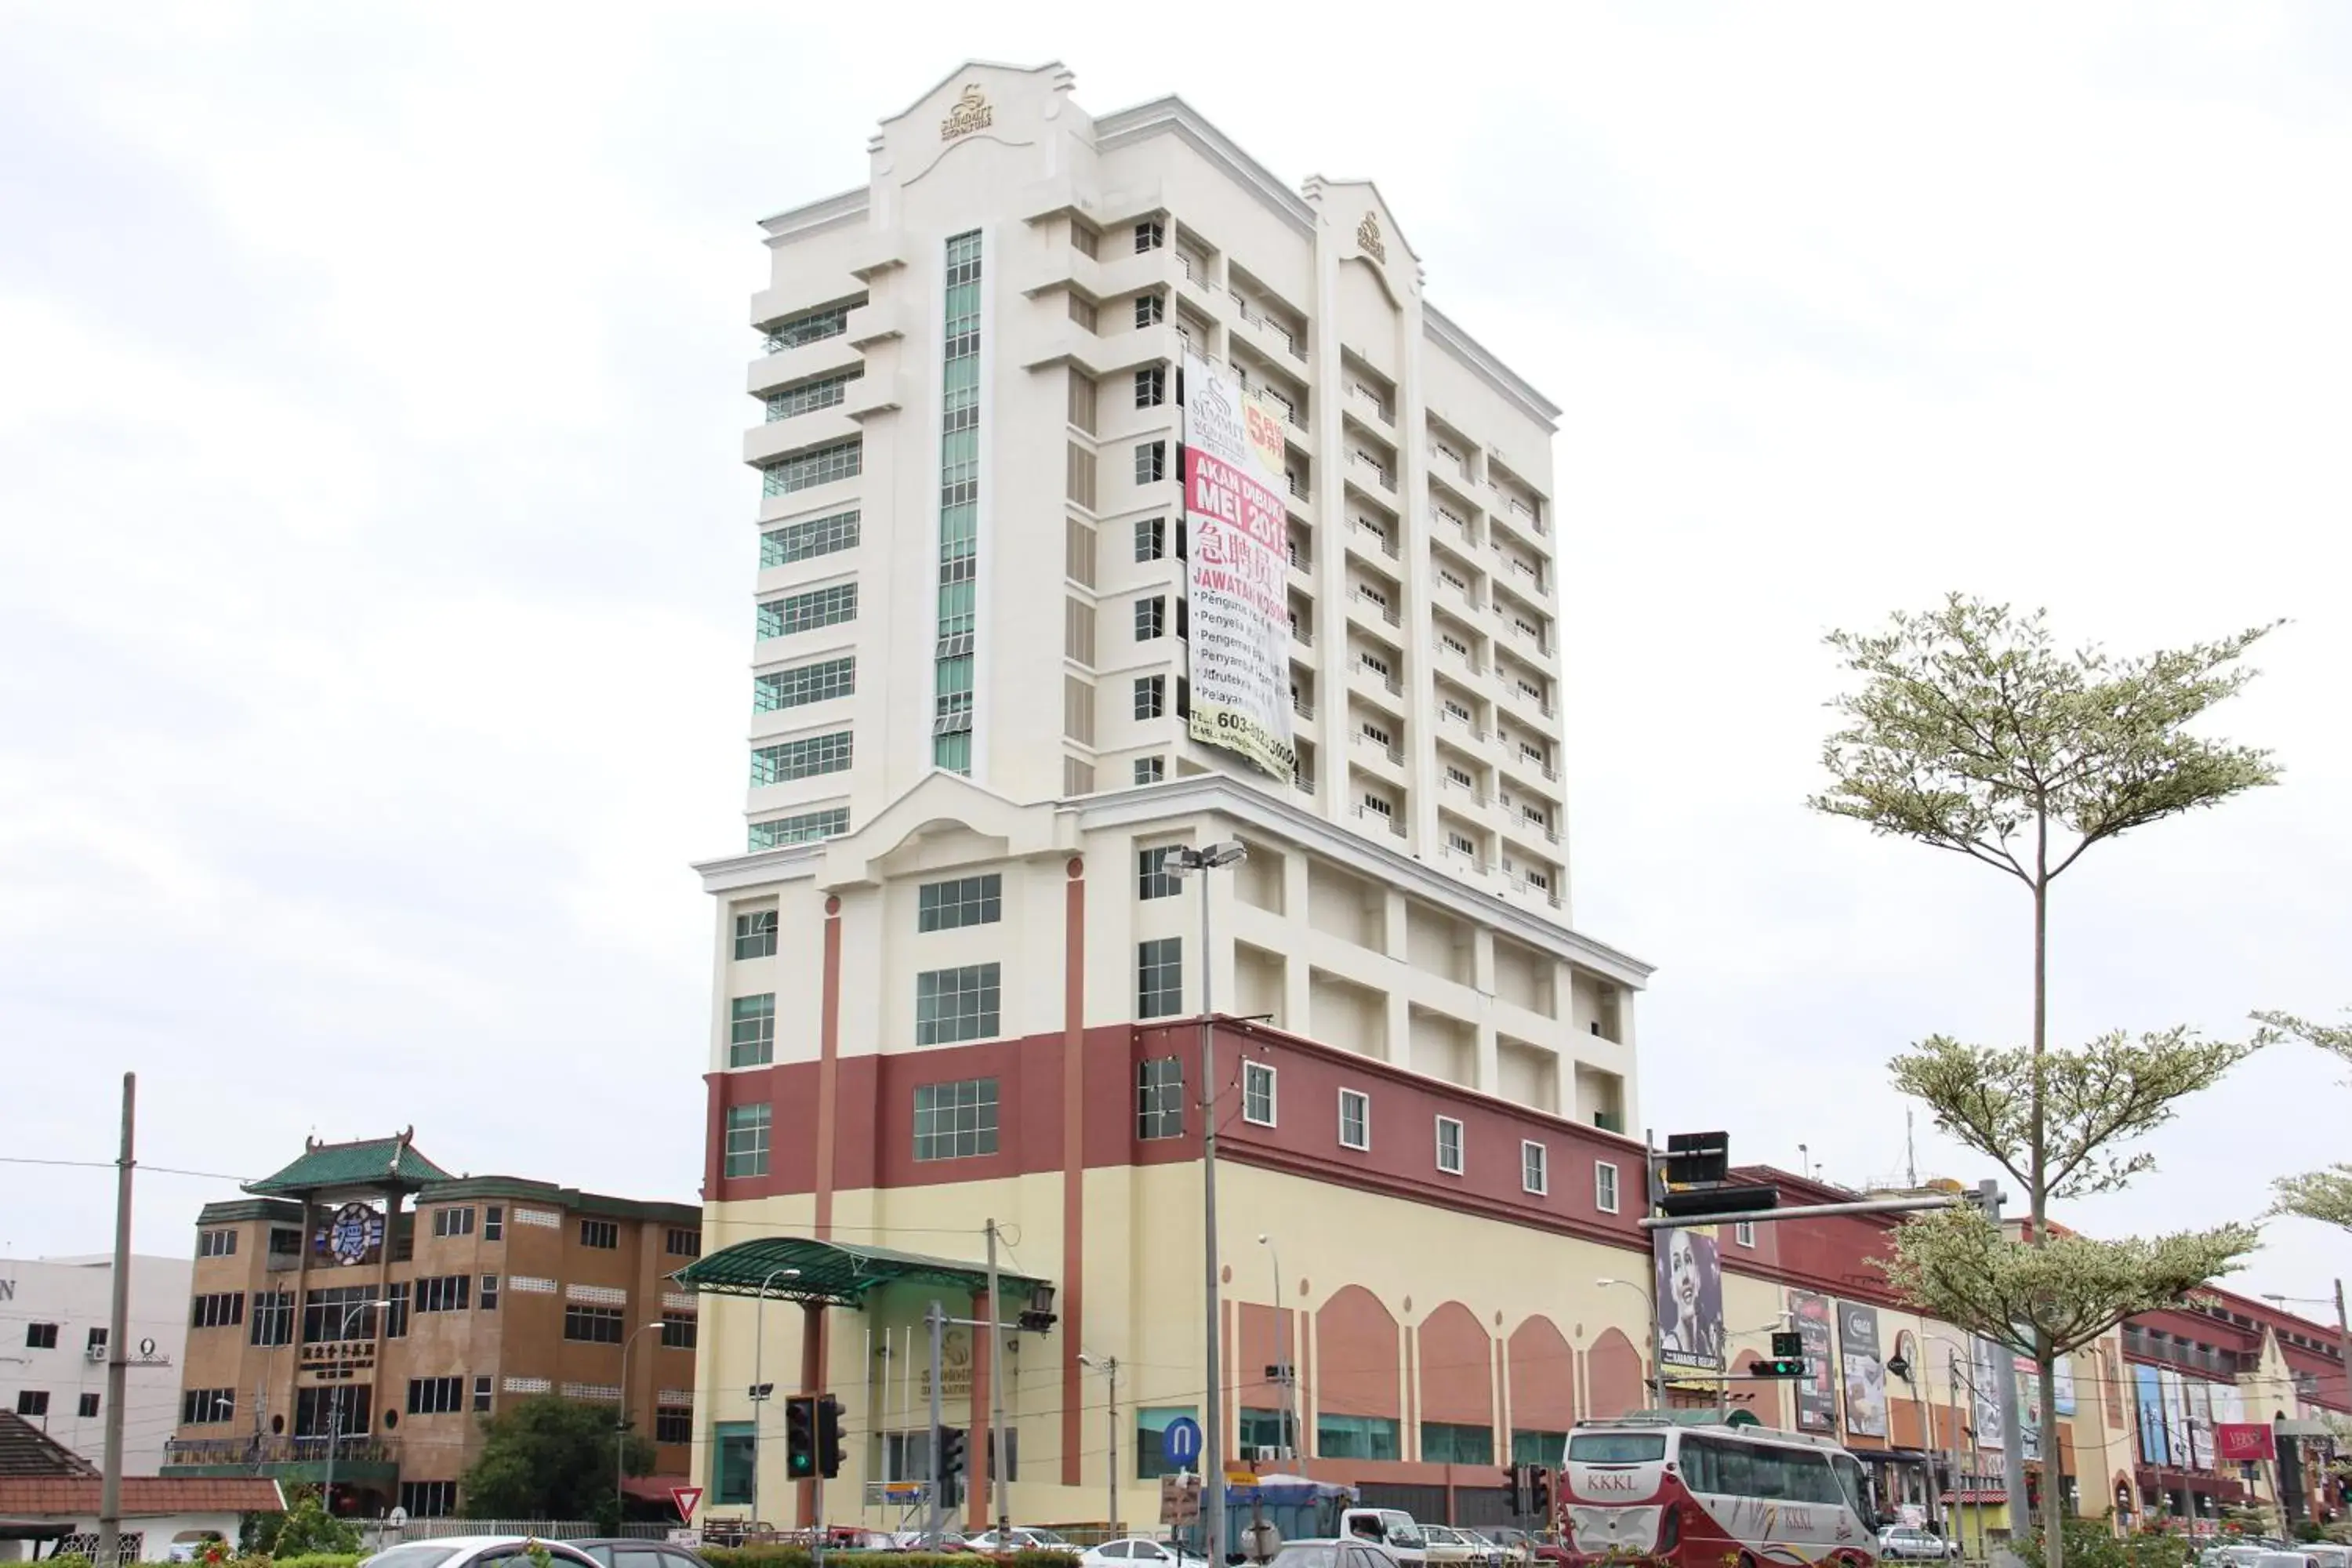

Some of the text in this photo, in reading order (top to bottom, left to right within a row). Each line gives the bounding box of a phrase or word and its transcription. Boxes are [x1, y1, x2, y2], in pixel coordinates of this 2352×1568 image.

[1196, 456, 1240, 492] AKAN
[1196, 477, 1242, 527] MEI
[1588, 1475, 1639, 1491] KKKL
